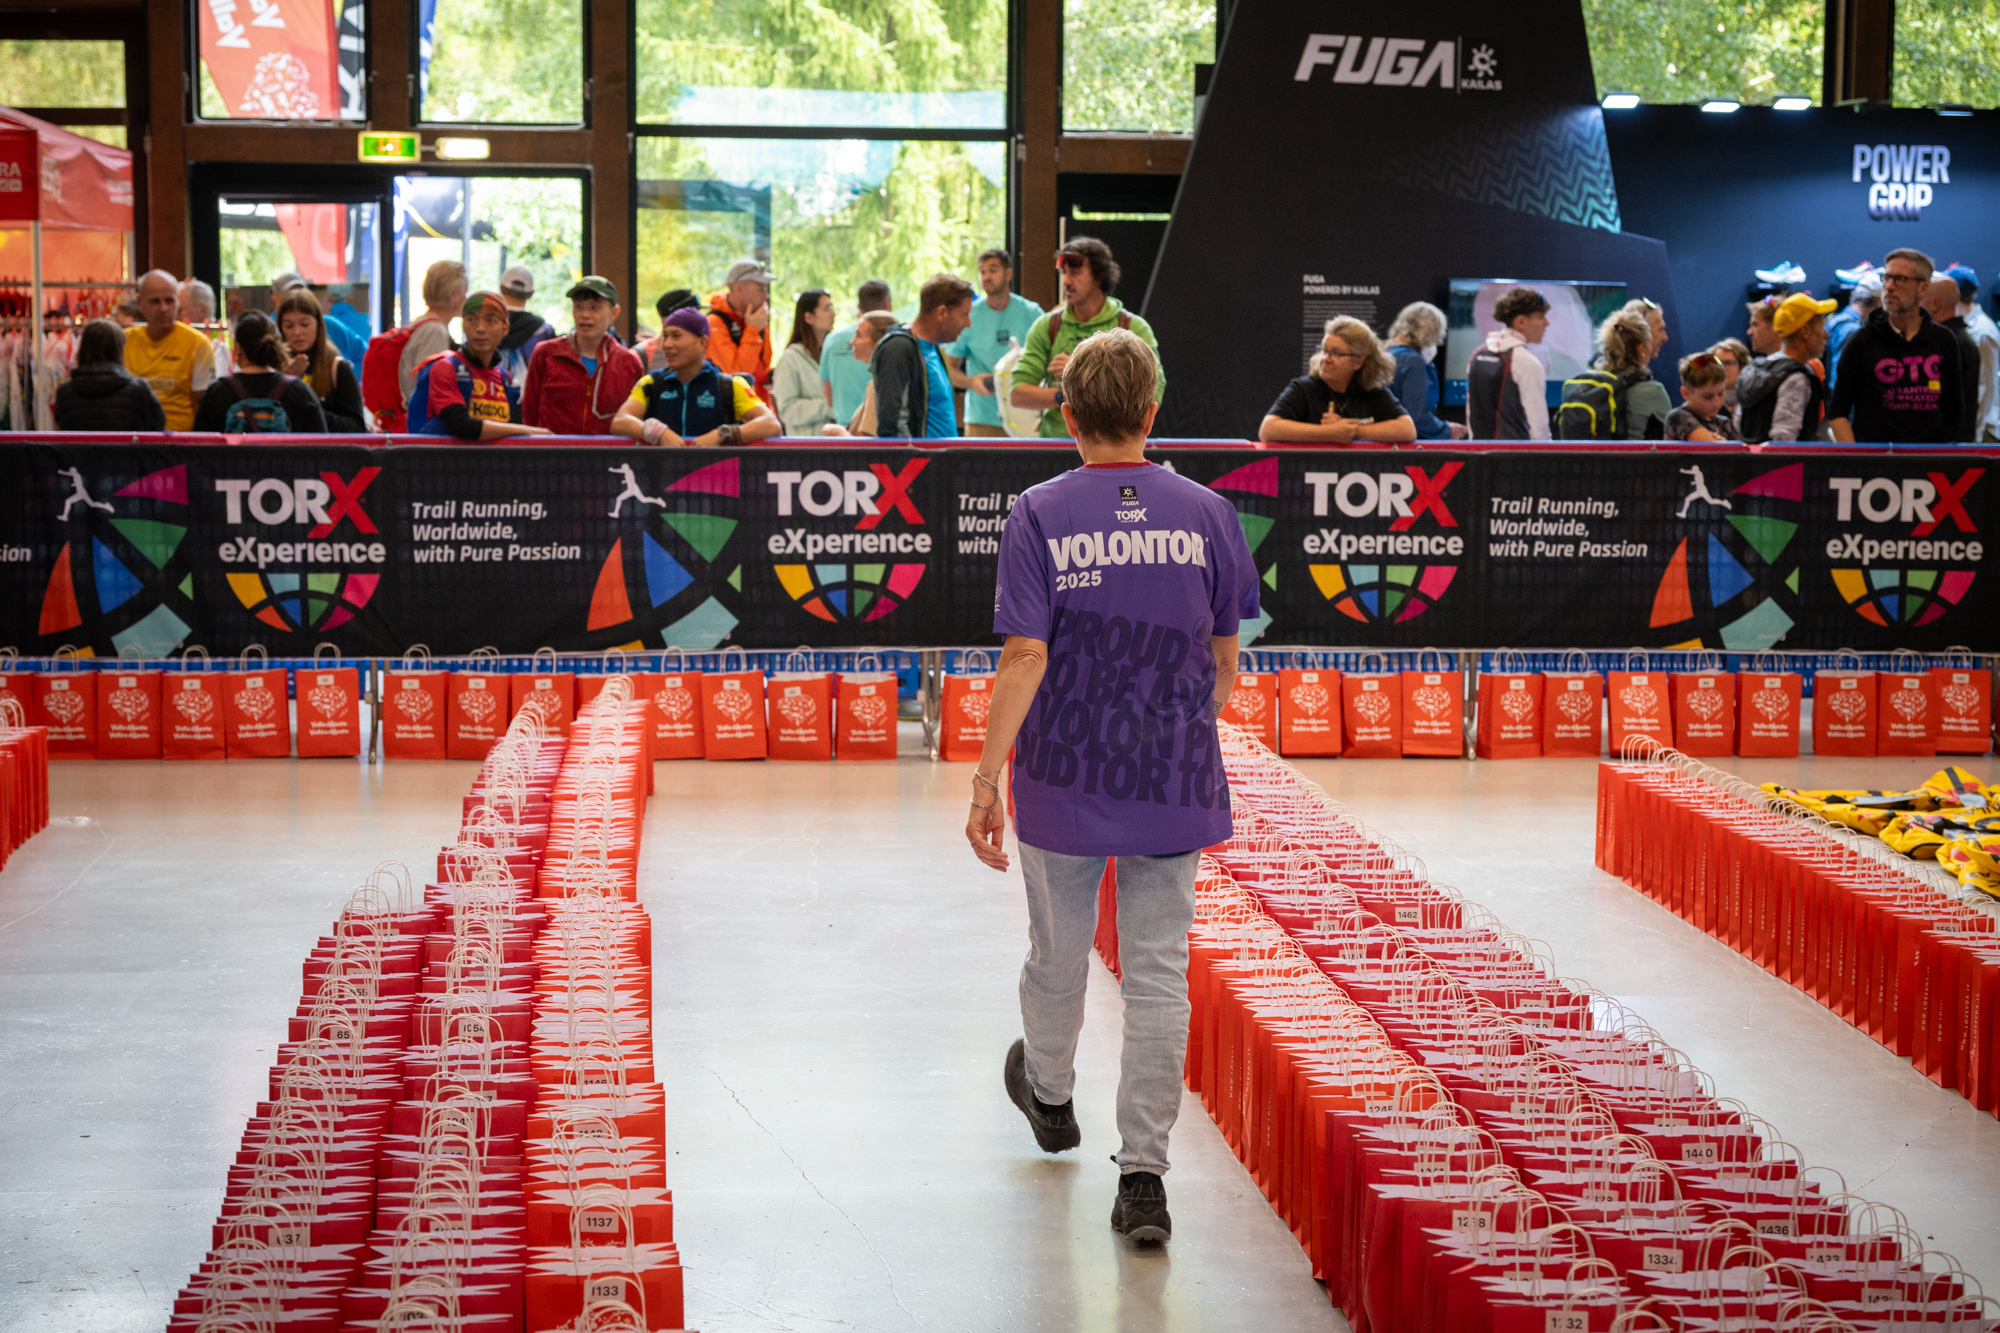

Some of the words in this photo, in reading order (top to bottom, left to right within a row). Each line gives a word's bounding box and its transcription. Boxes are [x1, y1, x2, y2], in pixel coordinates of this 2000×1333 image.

[1294, 33, 1456, 88] FUGA
[1461, 78, 1503, 91] KAILAS
[1852, 144, 1950, 183] POWER
[1869, 182, 1933, 221] GRIP
[1303, 285, 1341, 295] POWERED
[1342, 285, 1352, 295] BY
[1353, 285, 1381, 295] KAILAS
[215, 467, 382, 538] TORX
[767, 457, 931, 530] TORX
[958, 493, 1001, 511] Trail
[1304, 461, 1465, 532] TORX
[1829, 468, 1986, 537] TORX
[412, 500, 456, 519] Trail
[461, 499, 548, 520] Running,
[1115, 507, 1148, 522] TORX
[1490, 496, 1533, 514] Trail
[1537, 497, 1619, 519] Running,
[412, 521, 518, 541] Worldwide,
[1489, 518, 1590, 538] Worldwide,
[218, 537, 387, 569] eXperience
[413, 544, 456, 563] with
[460, 545, 503, 562] Pure
[507, 542, 582, 561] Passion
[768, 528, 932, 560] eXperience
[958, 537, 999, 554] with
[1047, 529, 1207, 573] VOLONTOR
[1303, 528, 1464, 561] eXperience
[1489, 539, 1529, 557] with
[1533, 540, 1575, 557] Pure
[1578, 539, 1648, 557] Passion
[1826, 533, 1984, 566] eXperience
[1055, 570, 1102, 592] 2025
[1051, 605, 1190, 675] PROUD
[1397, 911, 1418, 919] 1462
[586, 1217, 613, 1227] 1137
[1760, 1225, 1789, 1235] 1436
